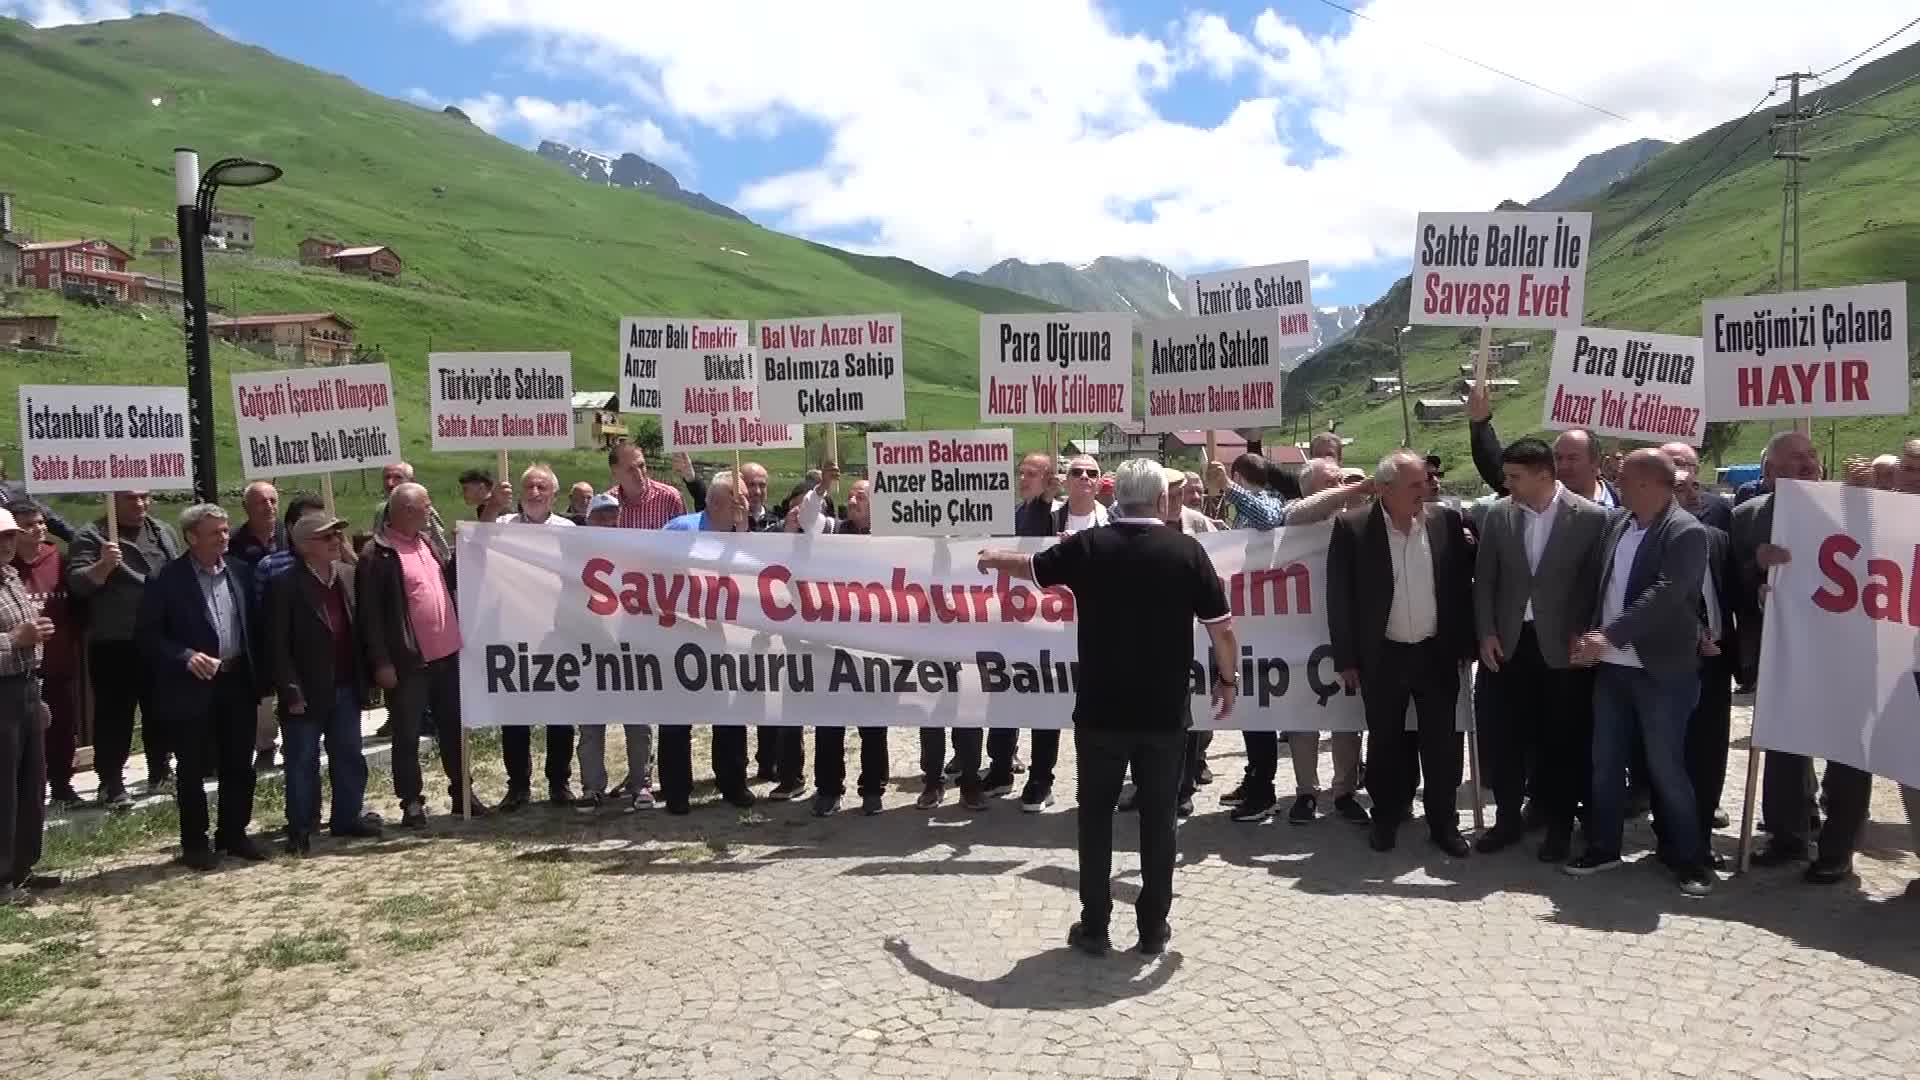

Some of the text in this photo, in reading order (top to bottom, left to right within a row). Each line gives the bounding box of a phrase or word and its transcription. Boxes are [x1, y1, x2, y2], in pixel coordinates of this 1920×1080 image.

[1422, 217, 1580, 268] Sahte Ballar İle
[1196, 276, 1304, 315] İzmir'de Satılan
[1424, 272, 1571, 322] Savaşa Evet
[630, 323, 737, 349] Anzer Balı Emektir
[762, 321, 894, 349] Bal Var Anzer Var
[1281, 313, 1308, 336] HAYIR
[1715, 302, 1892, 356] Emeğimizi Çalana
[1000, 323, 1111, 369] Para Uğruna
[1152, 329, 1269, 374] Ankara'da Satılan
[1572, 336, 1695, 387] Para Uğruna
[625, 353, 656, 378] Anzer
[704, 354, 745, 381] Dikkat
[765, 353, 894, 382] Balımıza Sahip
[1737, 360, 1871, 407] HAYIR
[238, 376, 389, 423] Coğrafi İşaretli Olmayan
[438, 367, 564, 404] Türkiye'de Satılan
[684, 388, 730, 417] Aldığın
[733, 386, 754, 410] Her
[797, 389, 863, 414] Çıkalım
[988, 375, 1124, 414] Anzer Yok Edilemez
[1150, 382, 1274, 417] Sahte Anzer Balına HAYIR
[27, 398, 184, 440] İstanbul'da Satılan
[438, 412, 568, 438] Sahte Anzer Balına HAYIR
[1552, 384, 1700, 436] Anzer Yok Edilemez
[249, 429, 392, 468] Bal Anzer Balı Değildir.
[673, 421, 708, 446] Anzer
[712, 419, 736, 443] Balı
[32, 453, 187, 481] Sahte Anzer Balına HAYIR
[872, 440, 1009, 465] Tarım Bakanım
[874, 468, 1010, 493] Anzer Balımıza
[891, 500, 993, 528] Sahip Çıkın
[581, 558, 1312, 628] Sayın Cumhurbaım
[486, 643, 661, 693] Rize'nin
[674, 643, 814, 692] Onuru
[829, 649, 963, 693] Anzer
